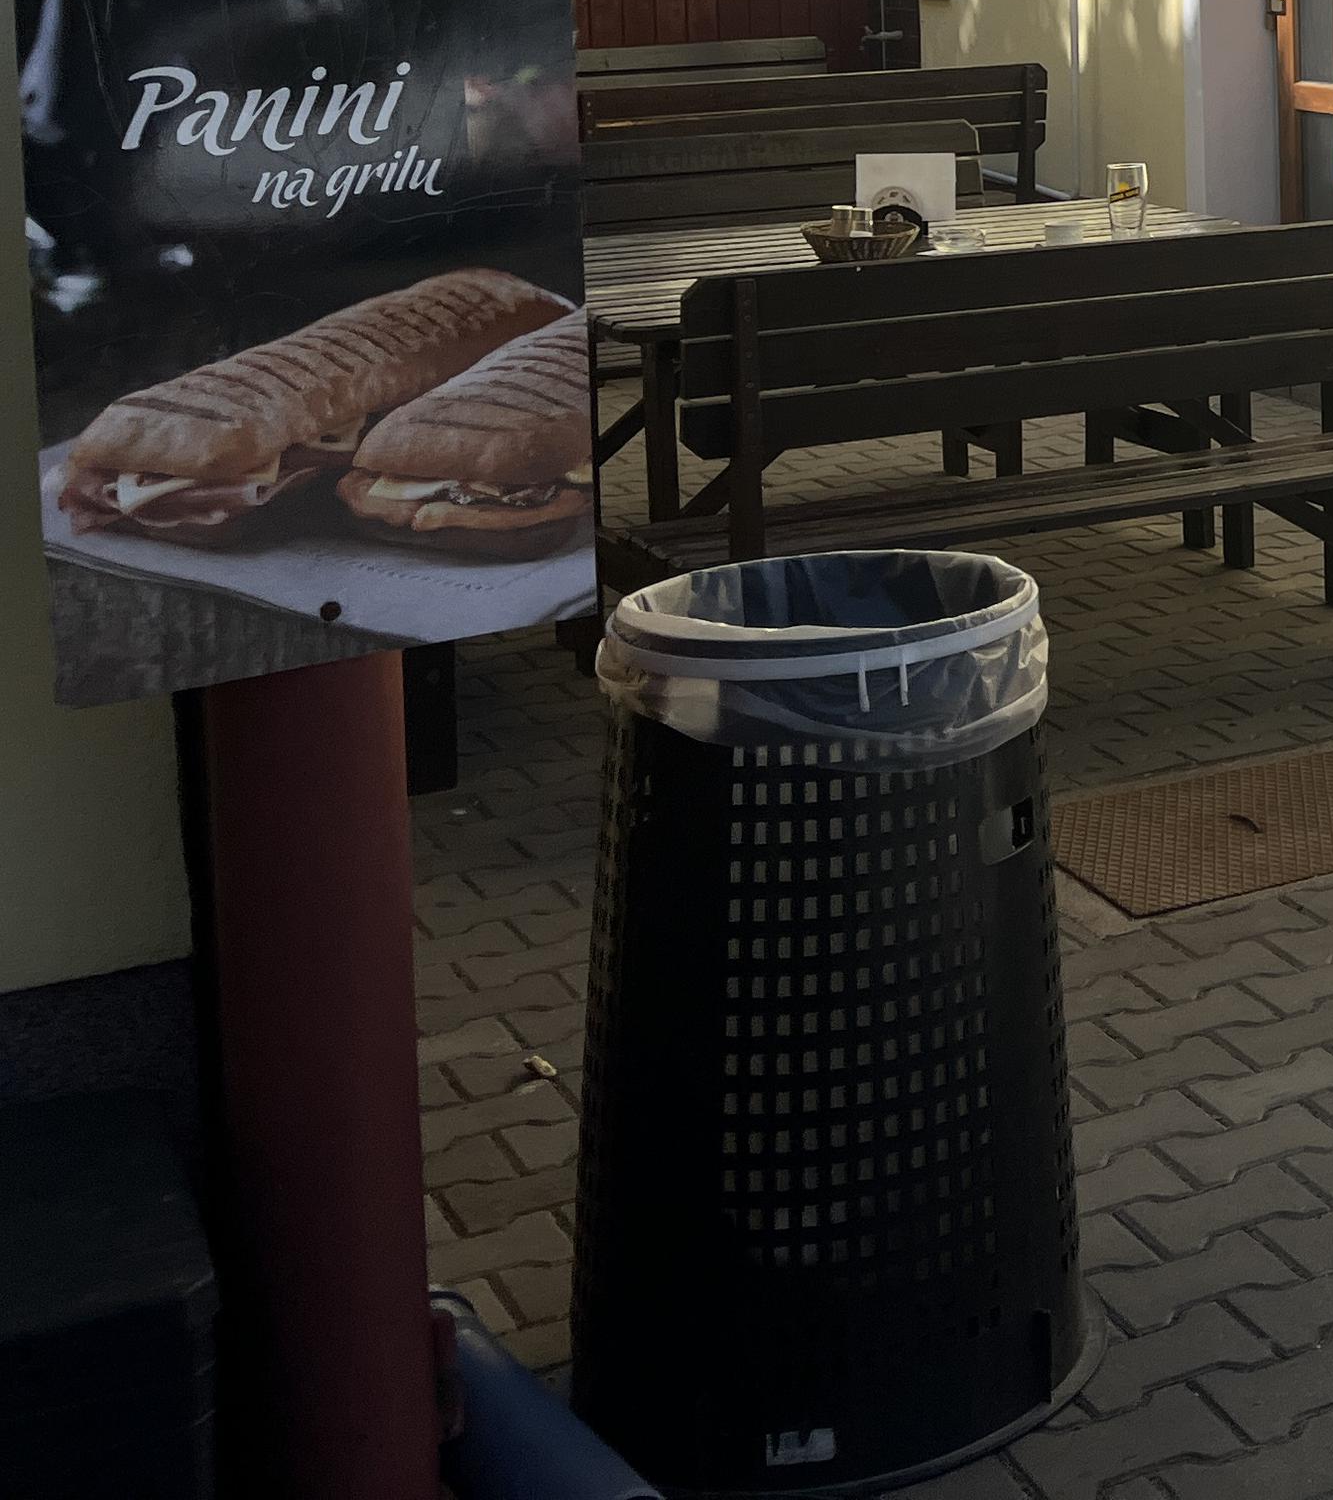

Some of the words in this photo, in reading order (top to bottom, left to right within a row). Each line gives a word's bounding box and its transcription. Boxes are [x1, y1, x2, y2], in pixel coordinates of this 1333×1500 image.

[120, 60, 412, 157] Panini
[251, 165, 317, 210] na
[325, 143, 445, 219] grilu
